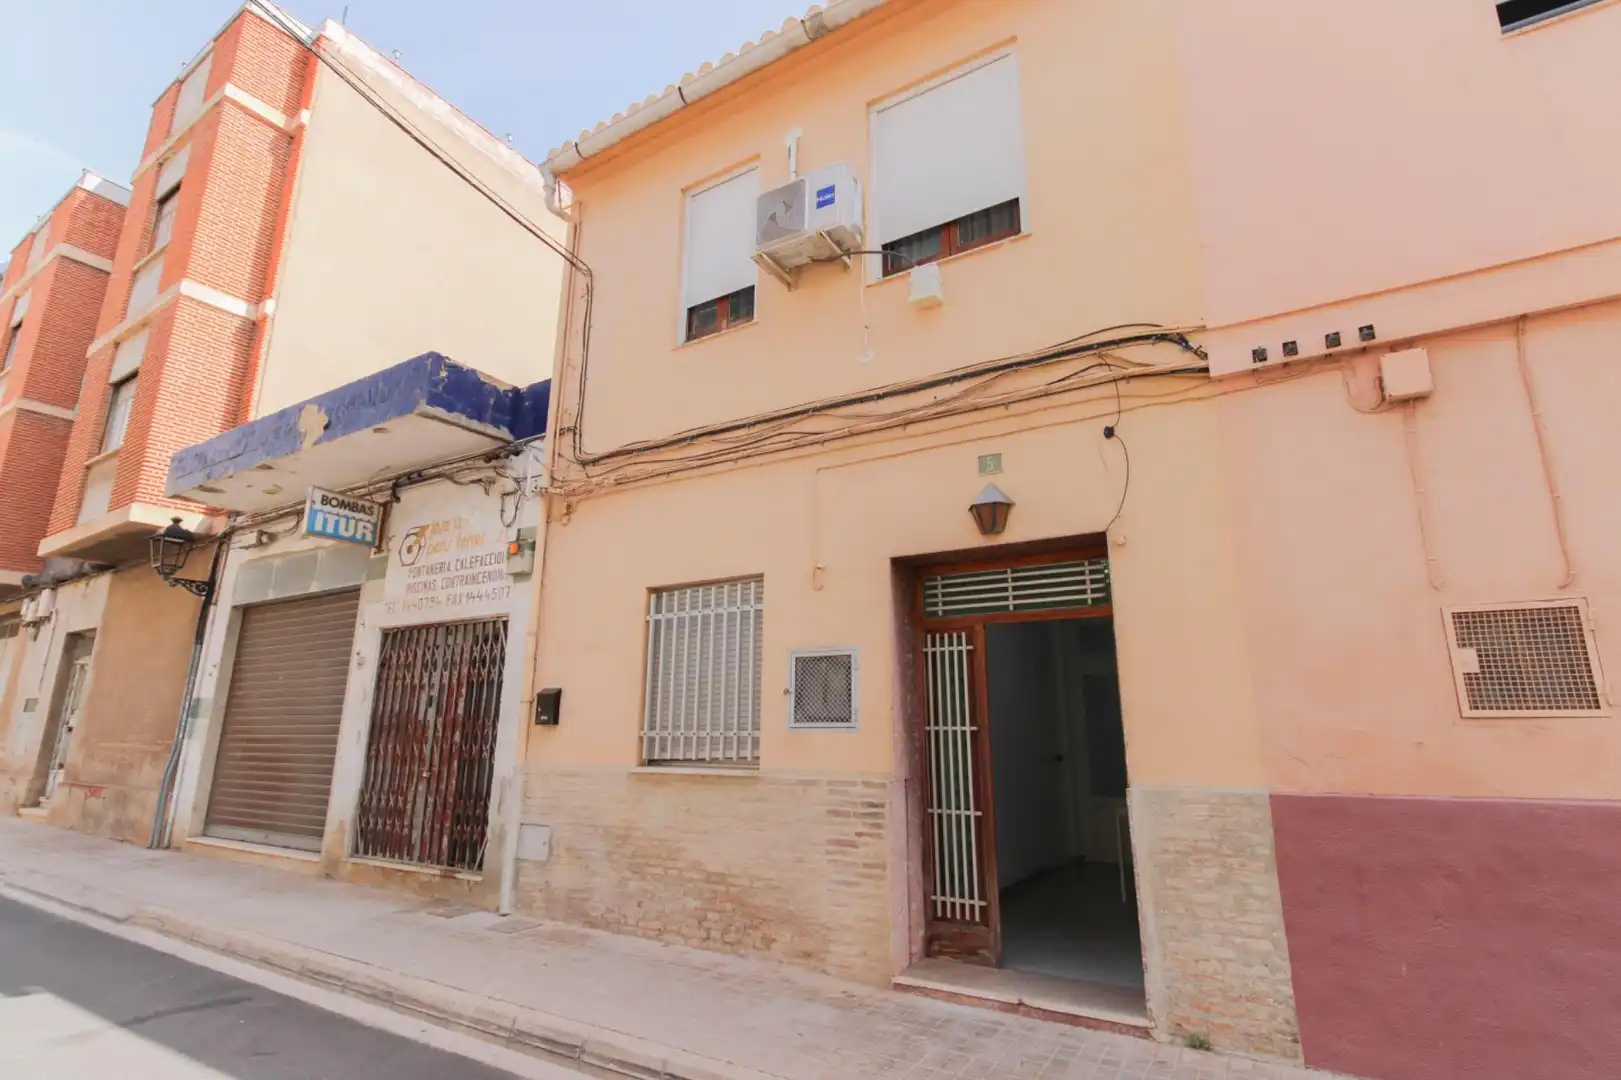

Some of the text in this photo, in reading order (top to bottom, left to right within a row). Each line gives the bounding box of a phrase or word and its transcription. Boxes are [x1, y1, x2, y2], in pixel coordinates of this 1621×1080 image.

[985, 456, 995, 472] 5
[320, 494, 374, 516] BOMBAS
[314, 510, 374, 541] ITUR
[445, 592, 463, 607] FAX
